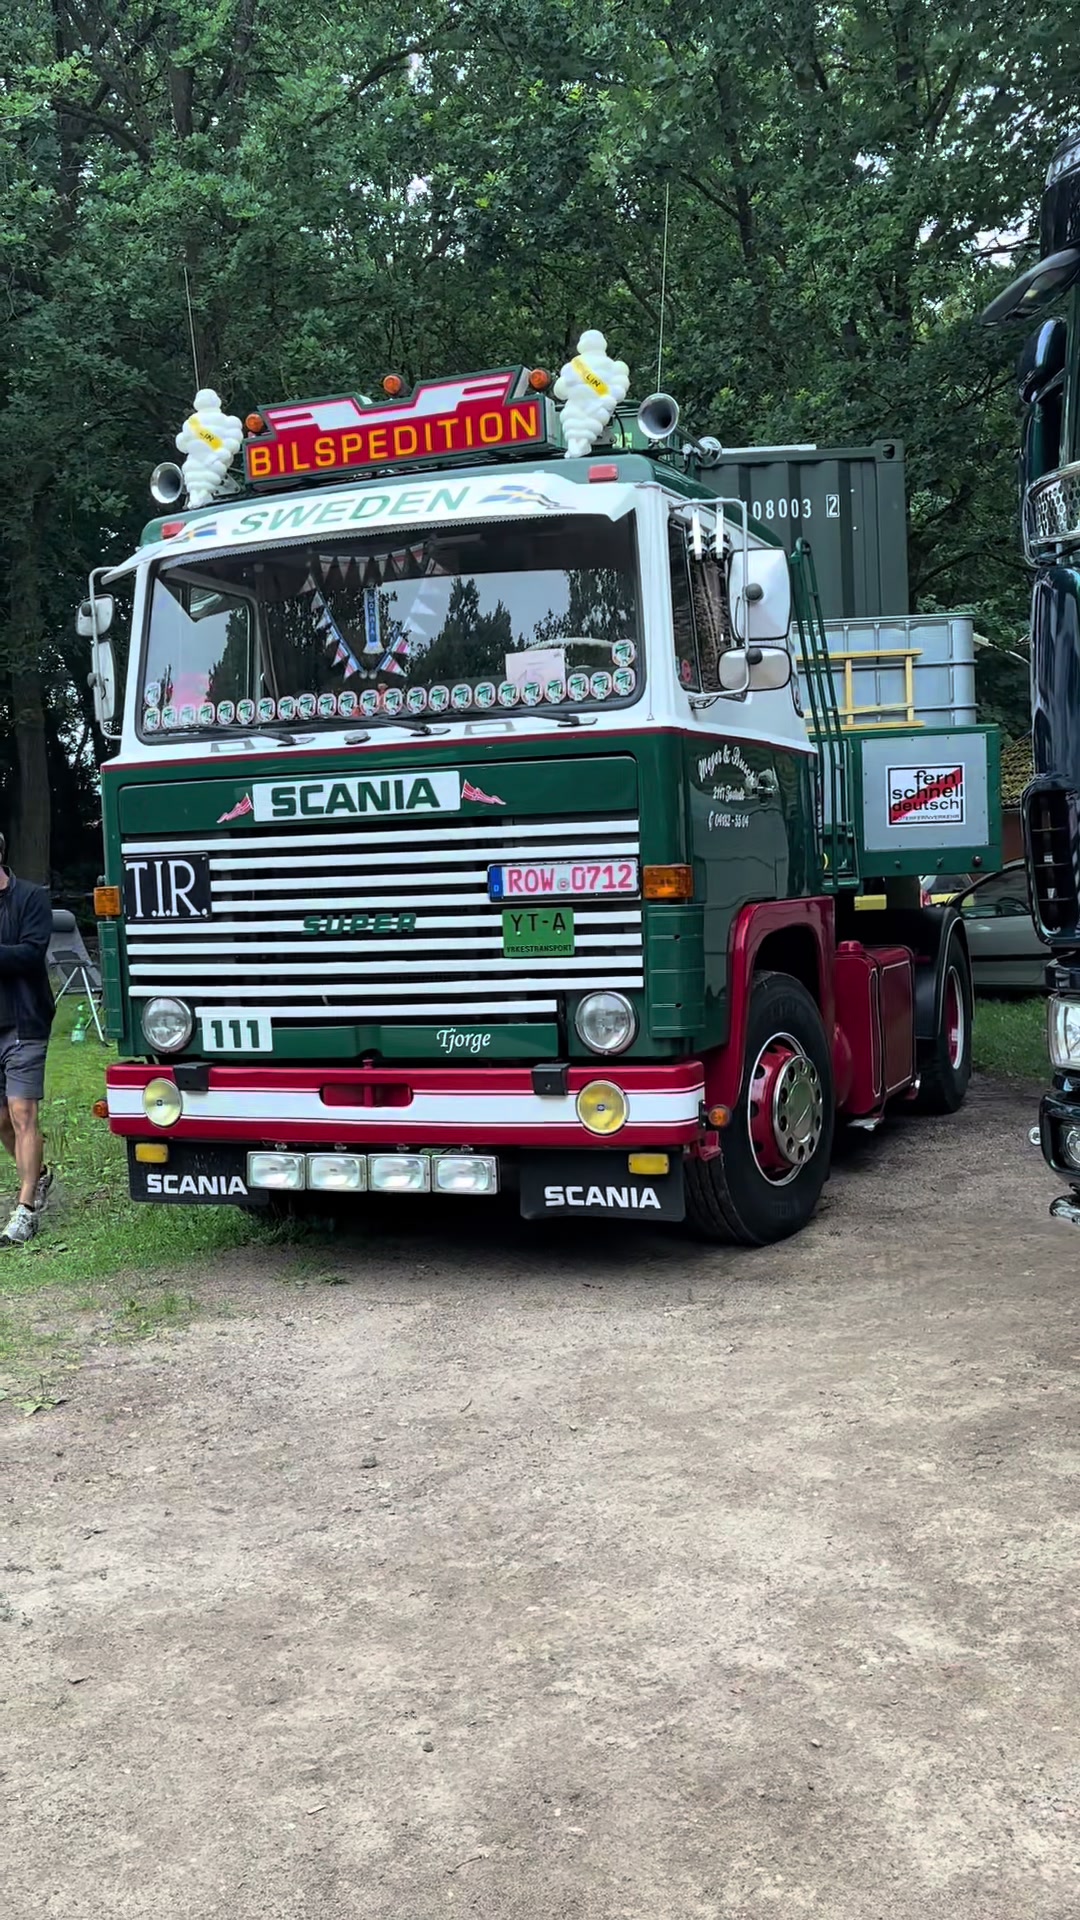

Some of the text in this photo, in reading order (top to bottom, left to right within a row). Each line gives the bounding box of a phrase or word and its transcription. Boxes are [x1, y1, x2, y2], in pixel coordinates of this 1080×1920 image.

[250, 405, 538, 477] BILSPEDITION
[231, 486, 471, 536] SWEDEN
[913, 770, 957, 786] fern
[271, 777, 441, 817] SCANIA
[892, 784, 963, 800] schnell
[892, 799, 960, 812] deutsch
[493, 884, 500, 893] D
[508, 864, 633, 893] ROW 0712
[301, 912, 417, 935] SUPER
[510, 912, 566, 932] YT-A
[210, 1019, 260, 1049] 111
[436, 1028, 491, 1054] Tjorge
[146, 1173, 249, 1195] SCANIA
[544, 1185, 662, 1209] SCANIA
